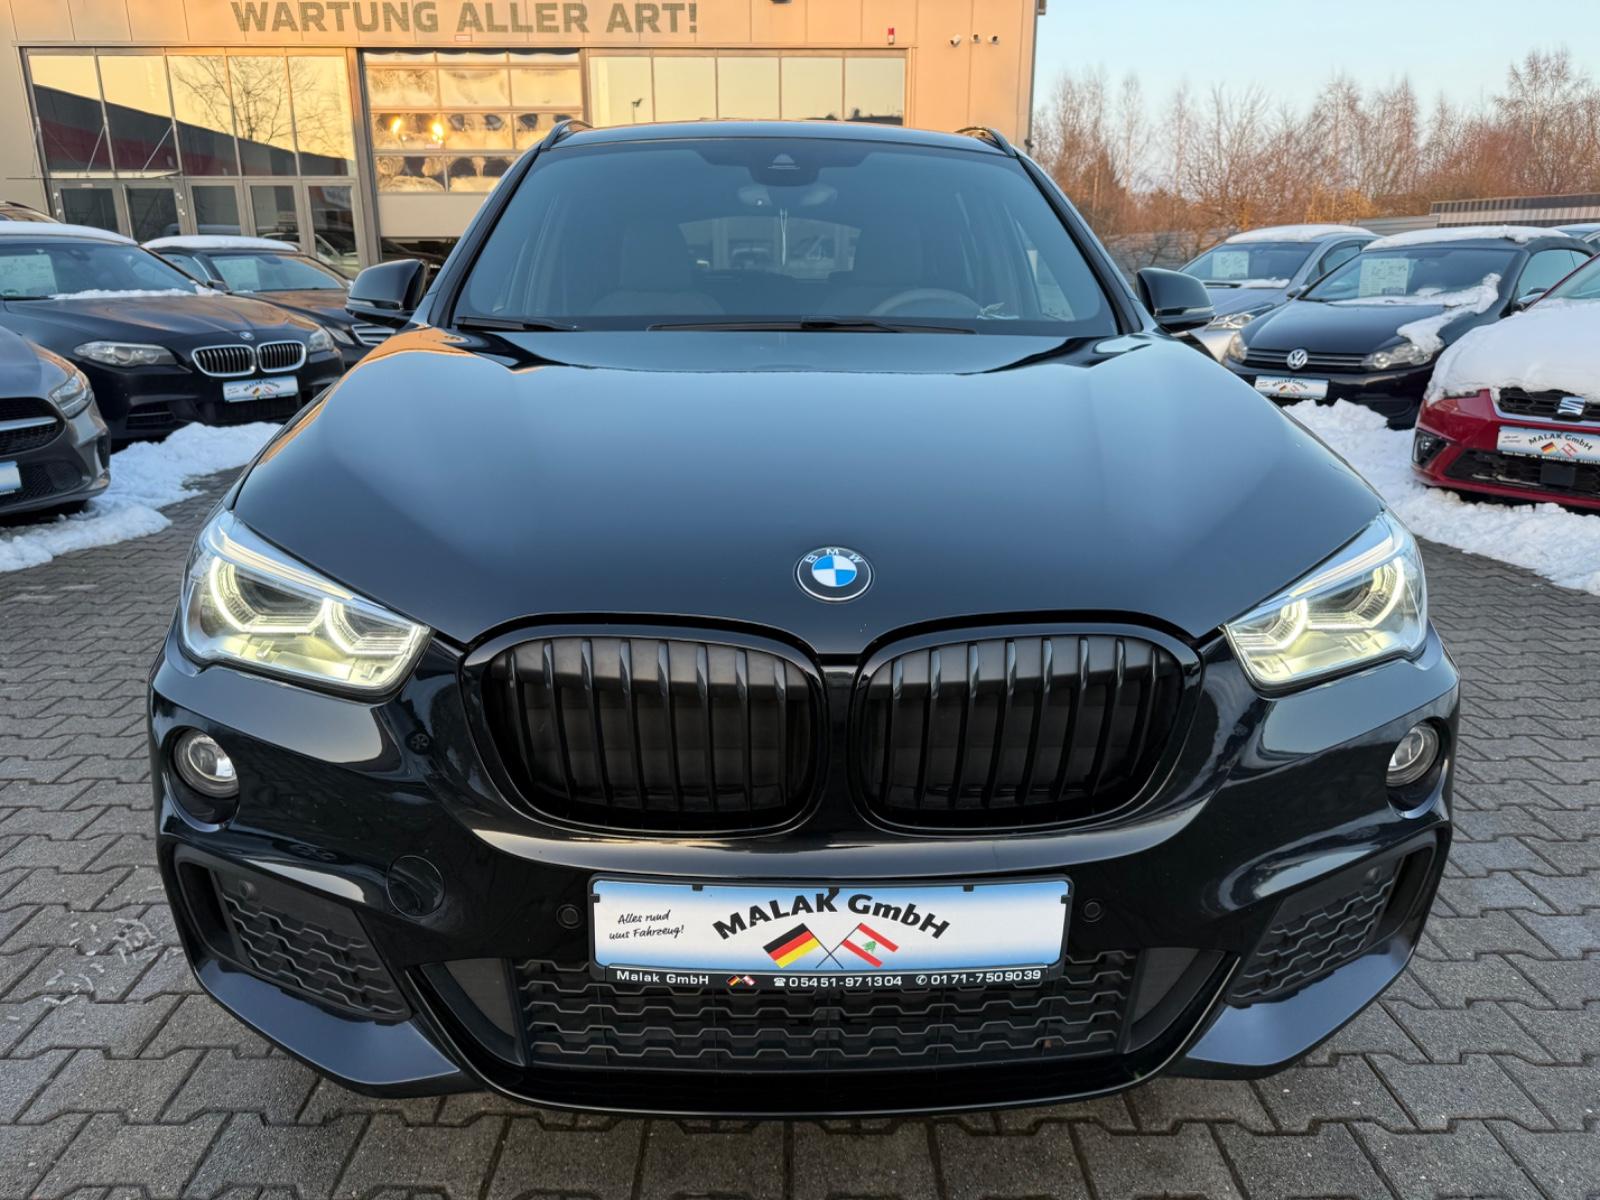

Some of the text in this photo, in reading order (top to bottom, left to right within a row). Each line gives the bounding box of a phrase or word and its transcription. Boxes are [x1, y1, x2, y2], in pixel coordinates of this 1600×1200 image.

[231, 2, 697, 33] WARTUNG ALLER ART!
[1529, 433, 1562, 445] MALAK
[1565, 434, 1593, 451] GmbH
[805, 548, 863, 563] BMW
[617, 909, 671, 924] Alles rund
[712, 893, 950, 940] MALAK GmbH
[609, 925, 684, 940] ums Fahrzeug!
[616, 969, 1041, 987] Malak GmbH 05451-971304 0171-7509039
